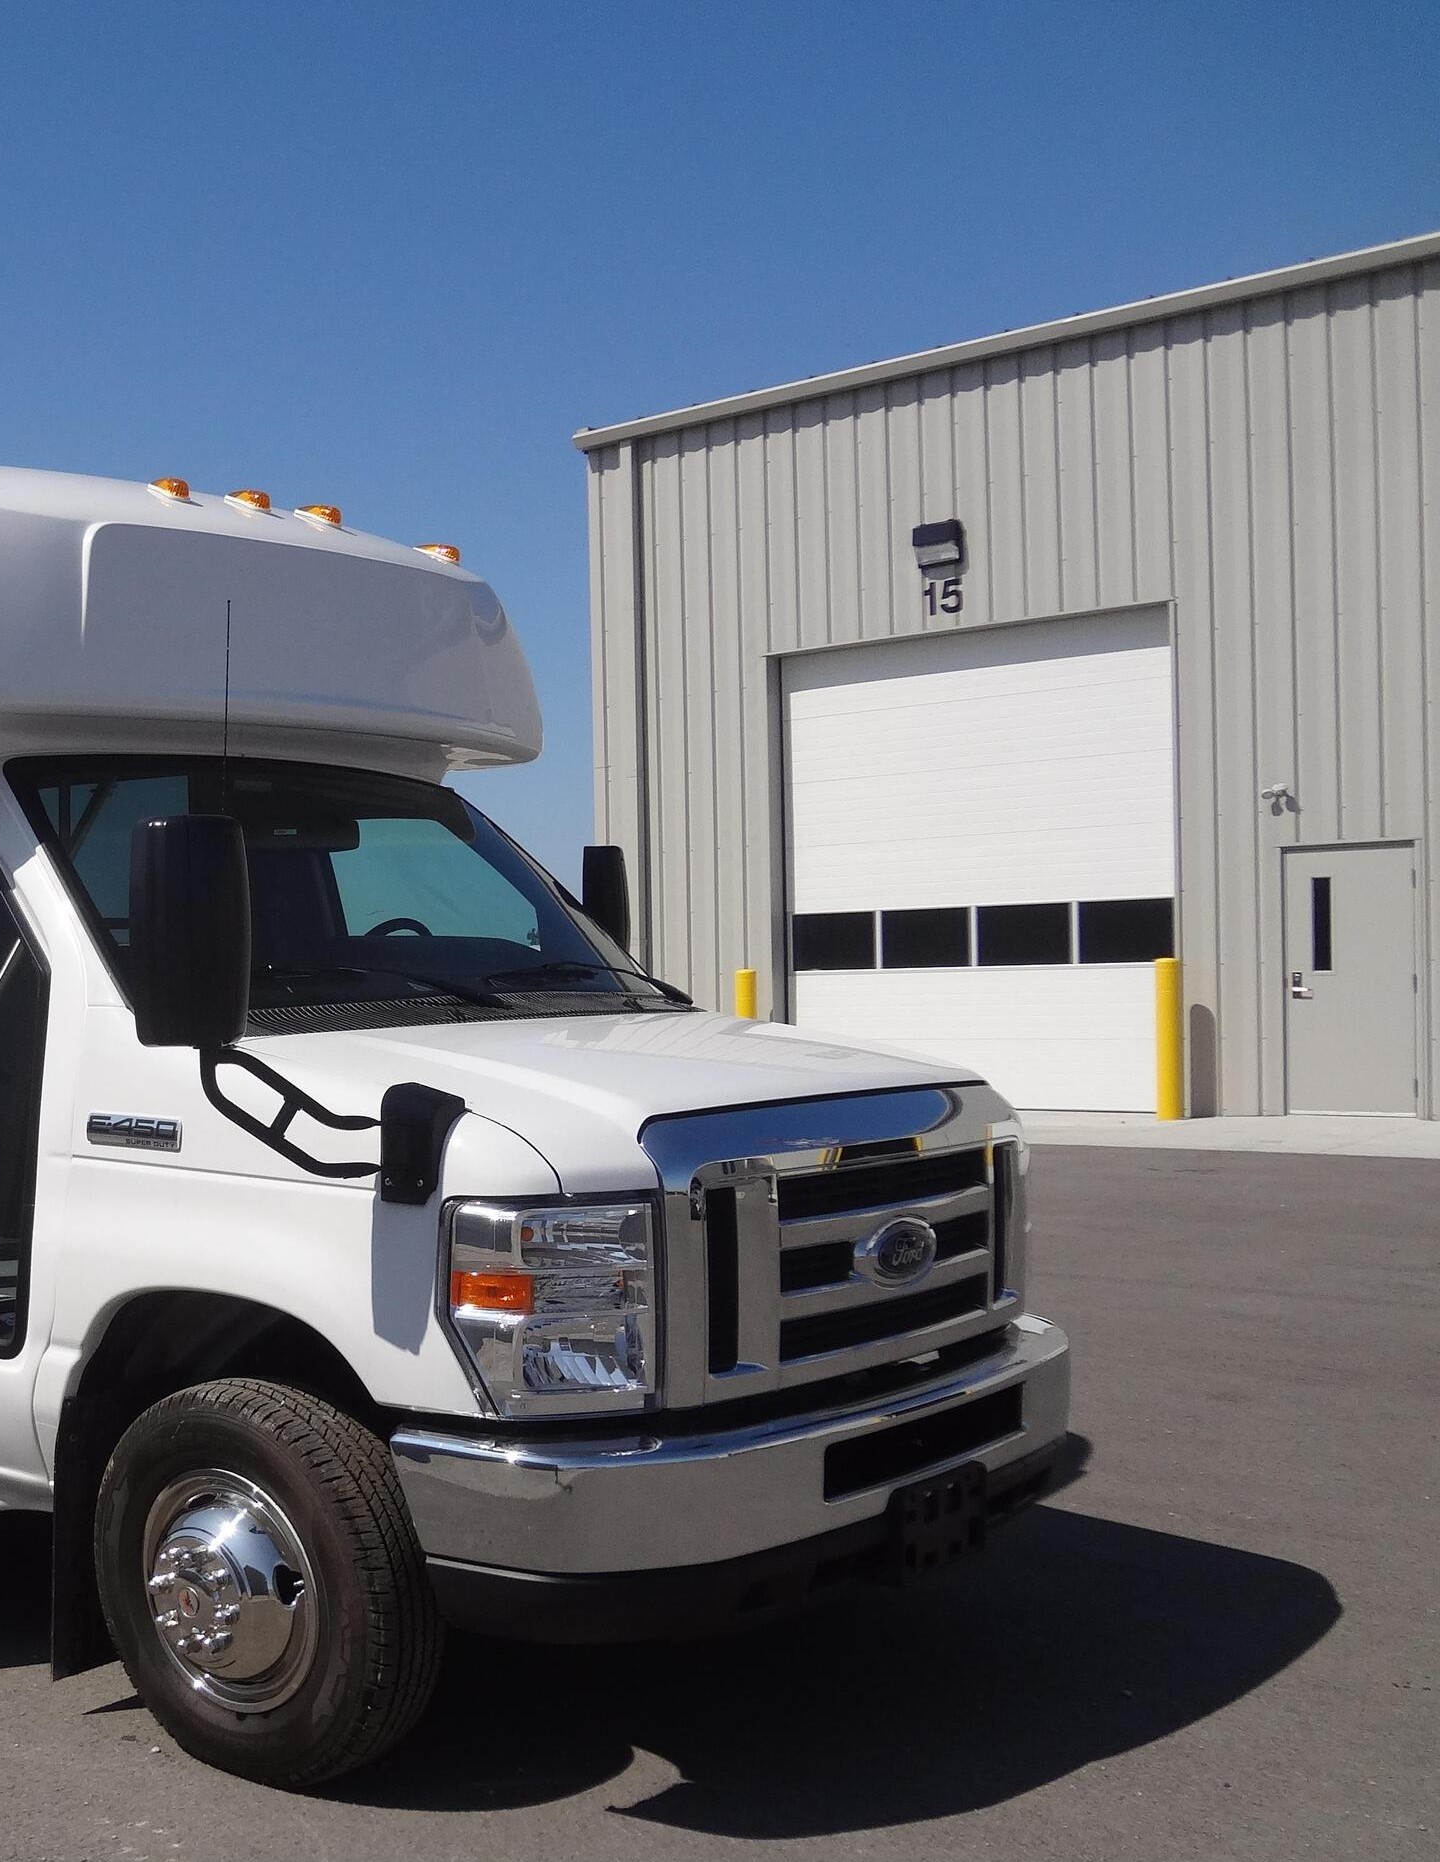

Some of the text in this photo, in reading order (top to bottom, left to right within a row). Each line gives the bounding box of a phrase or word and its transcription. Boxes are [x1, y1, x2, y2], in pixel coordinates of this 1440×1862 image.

[924, 578, 964, 616] 15
[125, 1138, 152, 1147] SUPER
[891, 1237, 925, 1267] Ford
